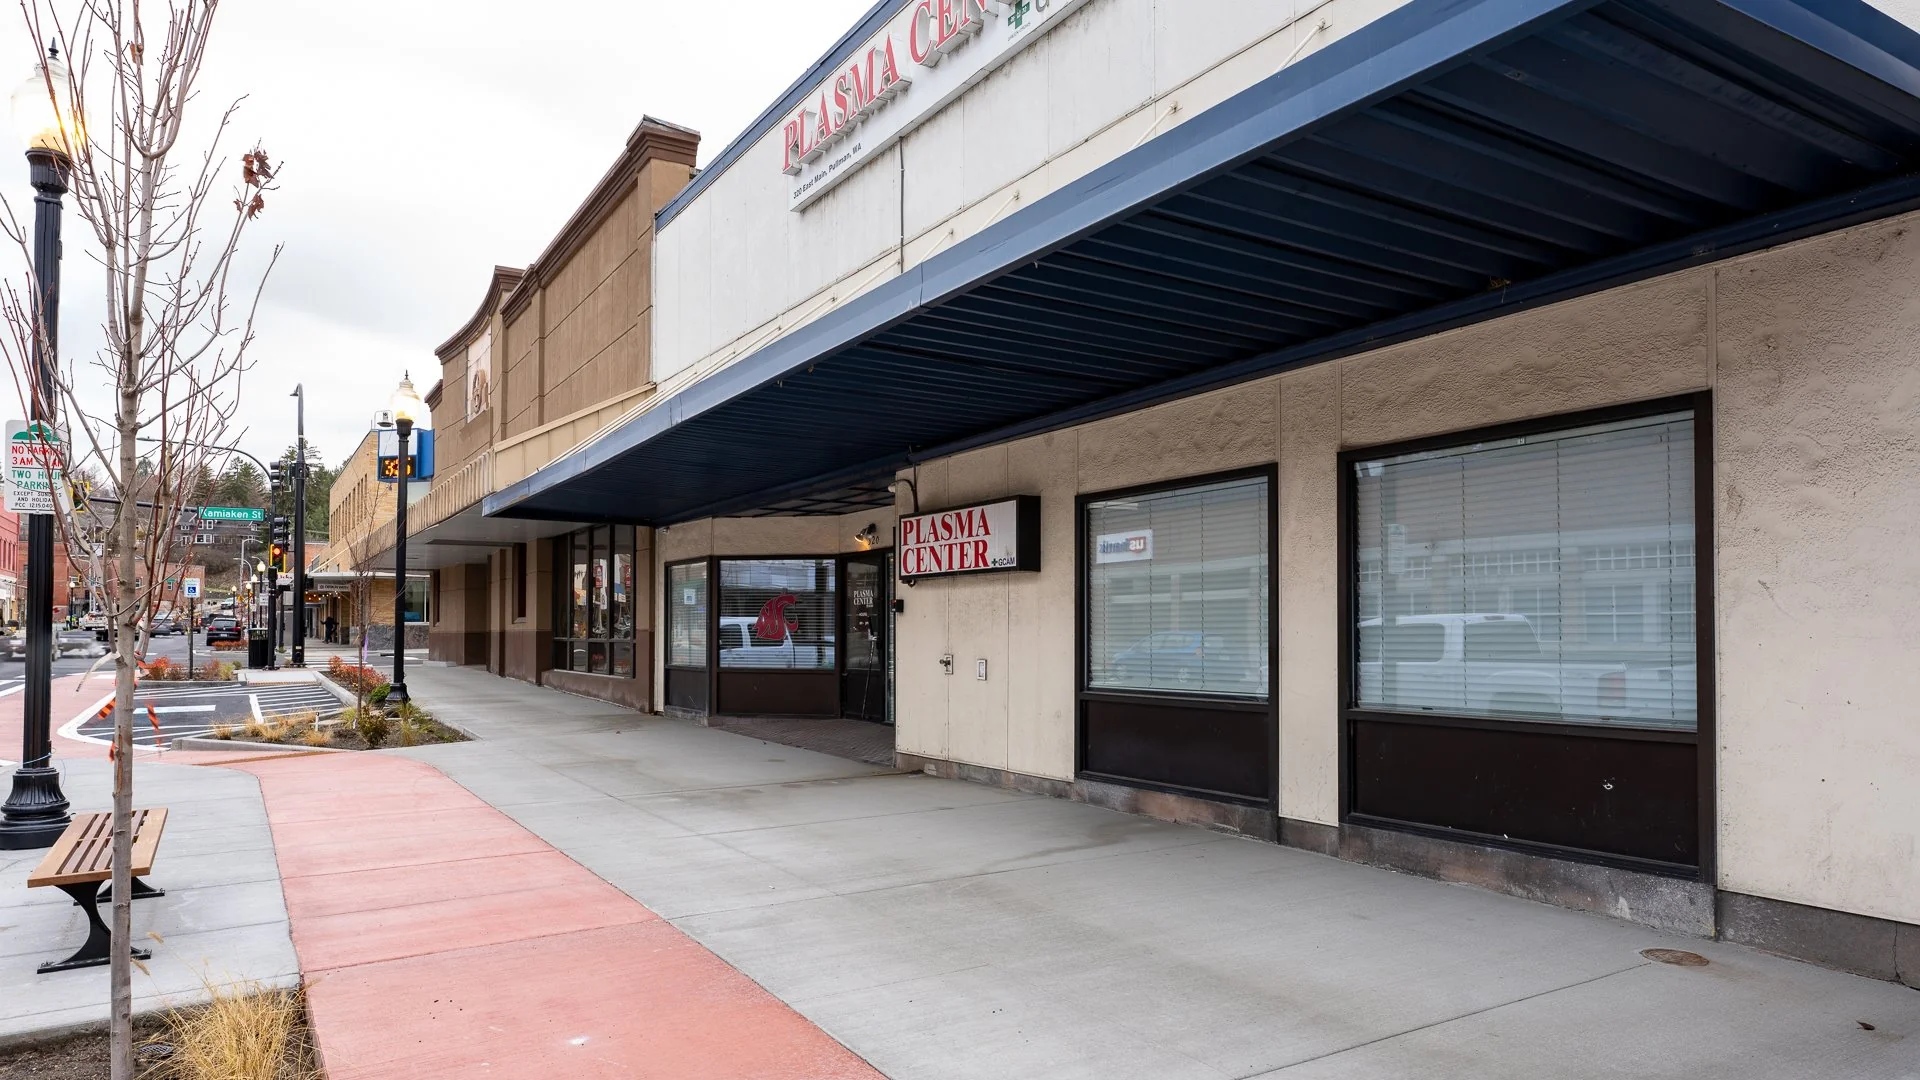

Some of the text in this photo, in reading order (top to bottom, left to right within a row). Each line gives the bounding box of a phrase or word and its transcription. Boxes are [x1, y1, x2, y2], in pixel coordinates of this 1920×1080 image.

[782, 32, 901, 172] PLASMA
[802, 179, 814, 192] East
[12, 446, 24, 454] NO
[12, 470, 31, 479] TWO
[201, 508, 261, 519] Kamiaken St
[901, 507, 991, 546] PLASMA
[902, 539, 1015, 574] CENTER GCAM
[853, 589, 874, 598] PLASMA
[853, 597, 874, 605] CENTER
